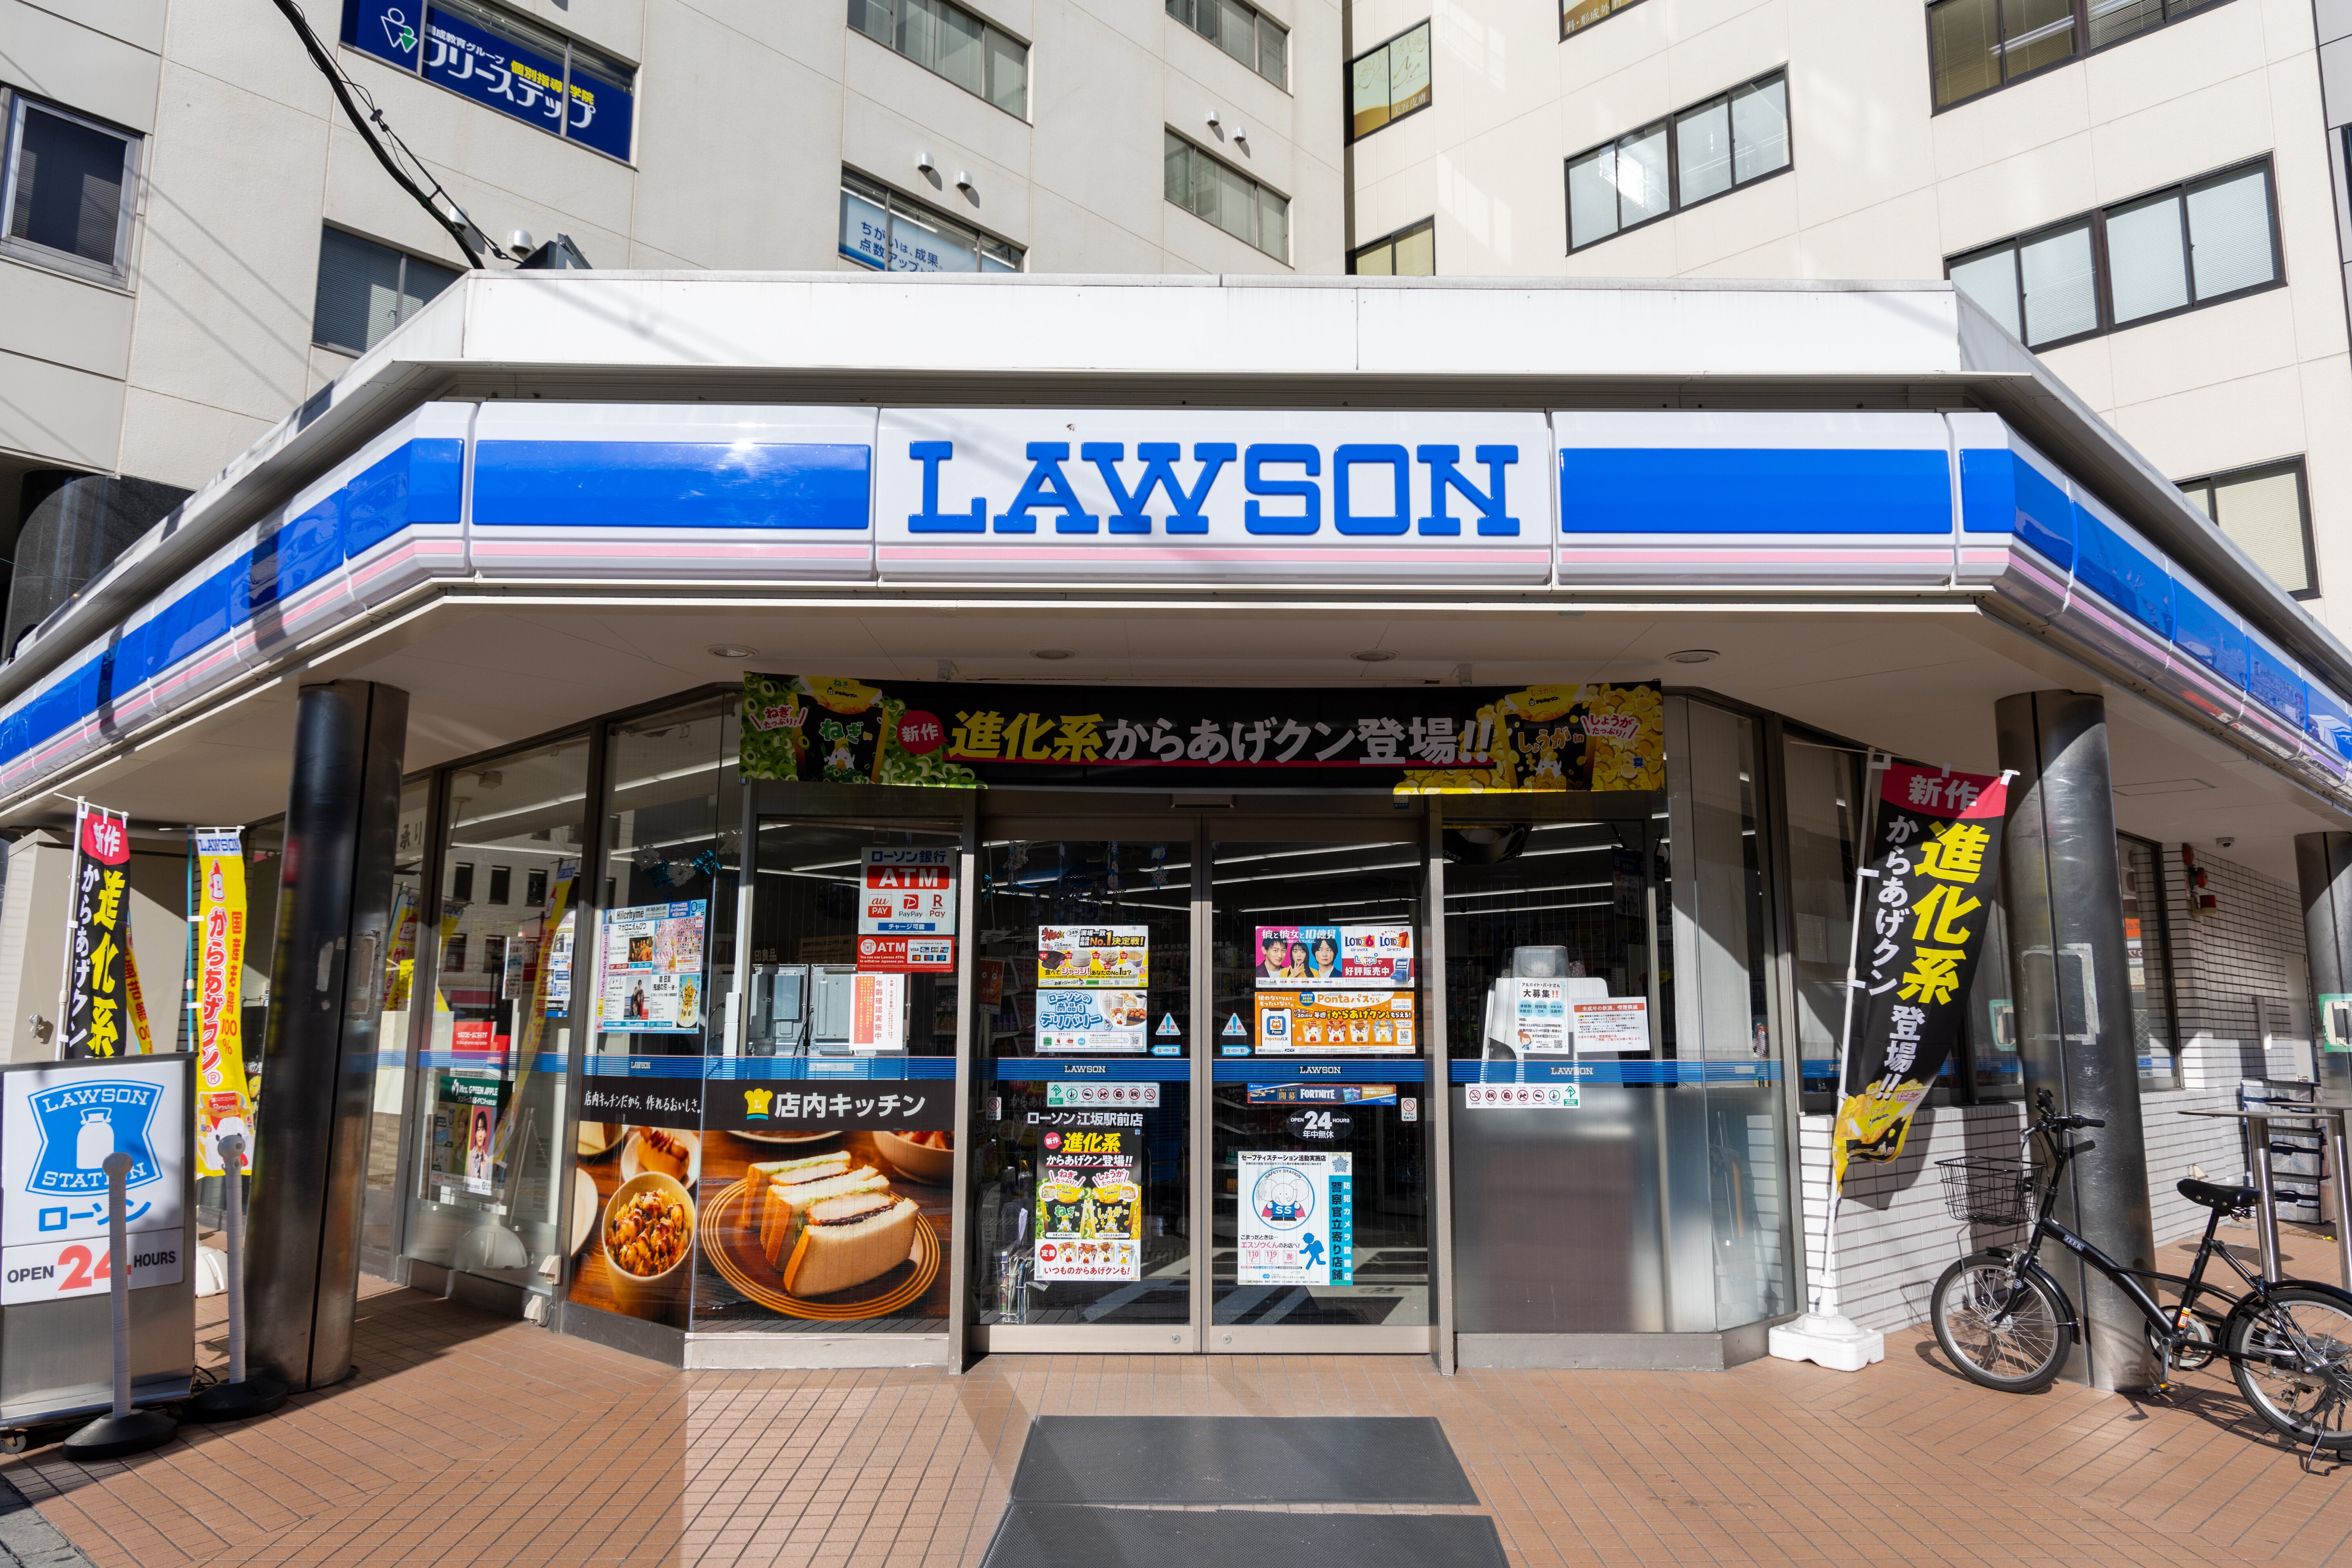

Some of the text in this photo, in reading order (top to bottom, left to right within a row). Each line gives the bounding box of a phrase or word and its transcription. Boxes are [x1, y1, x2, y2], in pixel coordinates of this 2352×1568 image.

[426, 23, 505, 63] 開成教育グループ
[423, 37, 596, 128] フリーステップ
[1394, 92, 1426, 116] 美容皮膚
[861, 221, 943, 270] ちがいは、成果。
[907, 441, 1521, 536] LAWSON
[765, 706, 792, 719] ねぎ
[1590, 713, 1636, 728] しょうが
[902, 722, 939, 742] 新作
[949, 710, 1495, 765] 進化系からあげクン登場!!
[1908, 774, 1980, 811] 新作
[93, 822, 121, 857] 新作
[198, 838, 241, 853] LAWSON
[871, 851, 946, 863] ローソン銀行
[879, 868, 938, 887] ATM
[871, 897, 889, 905] au
[1869, 815, 1919, 996] からあげクン
[616, 910, 644, 921] Hilcrhyme
[930, 910, 946, 918] Pay
[1897, 822, 1991, 1006] 進化系
[618, 923, 646, 931] マカロニえんぴつ
[1262, 929, 1336, 939] 彼と彼女と10億男
[877, 942, 906, 952] ATM
[69, 864, 99, 1048] からあげクン
[87, 869, 125, 1056] 進化系
[1345, 967, 1390, 976] 好評販売中
[1047, 991, 1091, 1004] ローソンの
[875, 980, 883, 1040] 年齢確認実施中
[1056, 1002, 1085, 1013] 商品を
[1039, 1012, 1102, 1029] デリバリー
[630, 1062, 651, 1070] LAWSON
[469, 1085, 484, 1095] GREEN
[483, 1087, 499, 1096] APPLE
[1300, 1089, 1335, 1099] FORTNITE
[42, 1088, 151, 1113] LAWSON
[775, 1092, 926, 1118] 店内キッチン
[1027, 1112, 1143, 1127] ローソン江坂駅前店
[1304, 1111, 1332, 1129] 24
[1062, 1132, 1122, 1153] 進化系
[1046, 1155, 1133, 1167] からあげクン登場!!
[42, 1163, 147, 1188] STATN
[1265, 1169, 1302, 1179] SAFETY STATION
[1275, 1206, 1292, 1214] SS
[1331, 1181, 1343, 1280] 警察官立寄り店舗
[1343, 1181, 1352, 1281] 防犯カメラ設置店
[2064, 1236, 2083, 1250] ZEEK
[1041, 1249, 1056, 1258] 定番
[7, 1265, 54, 1283] OPEN
[133, 1251, 176, 1268] HOURS
[1044, 1266, 1130, 1276] いつものからあげクンも!
